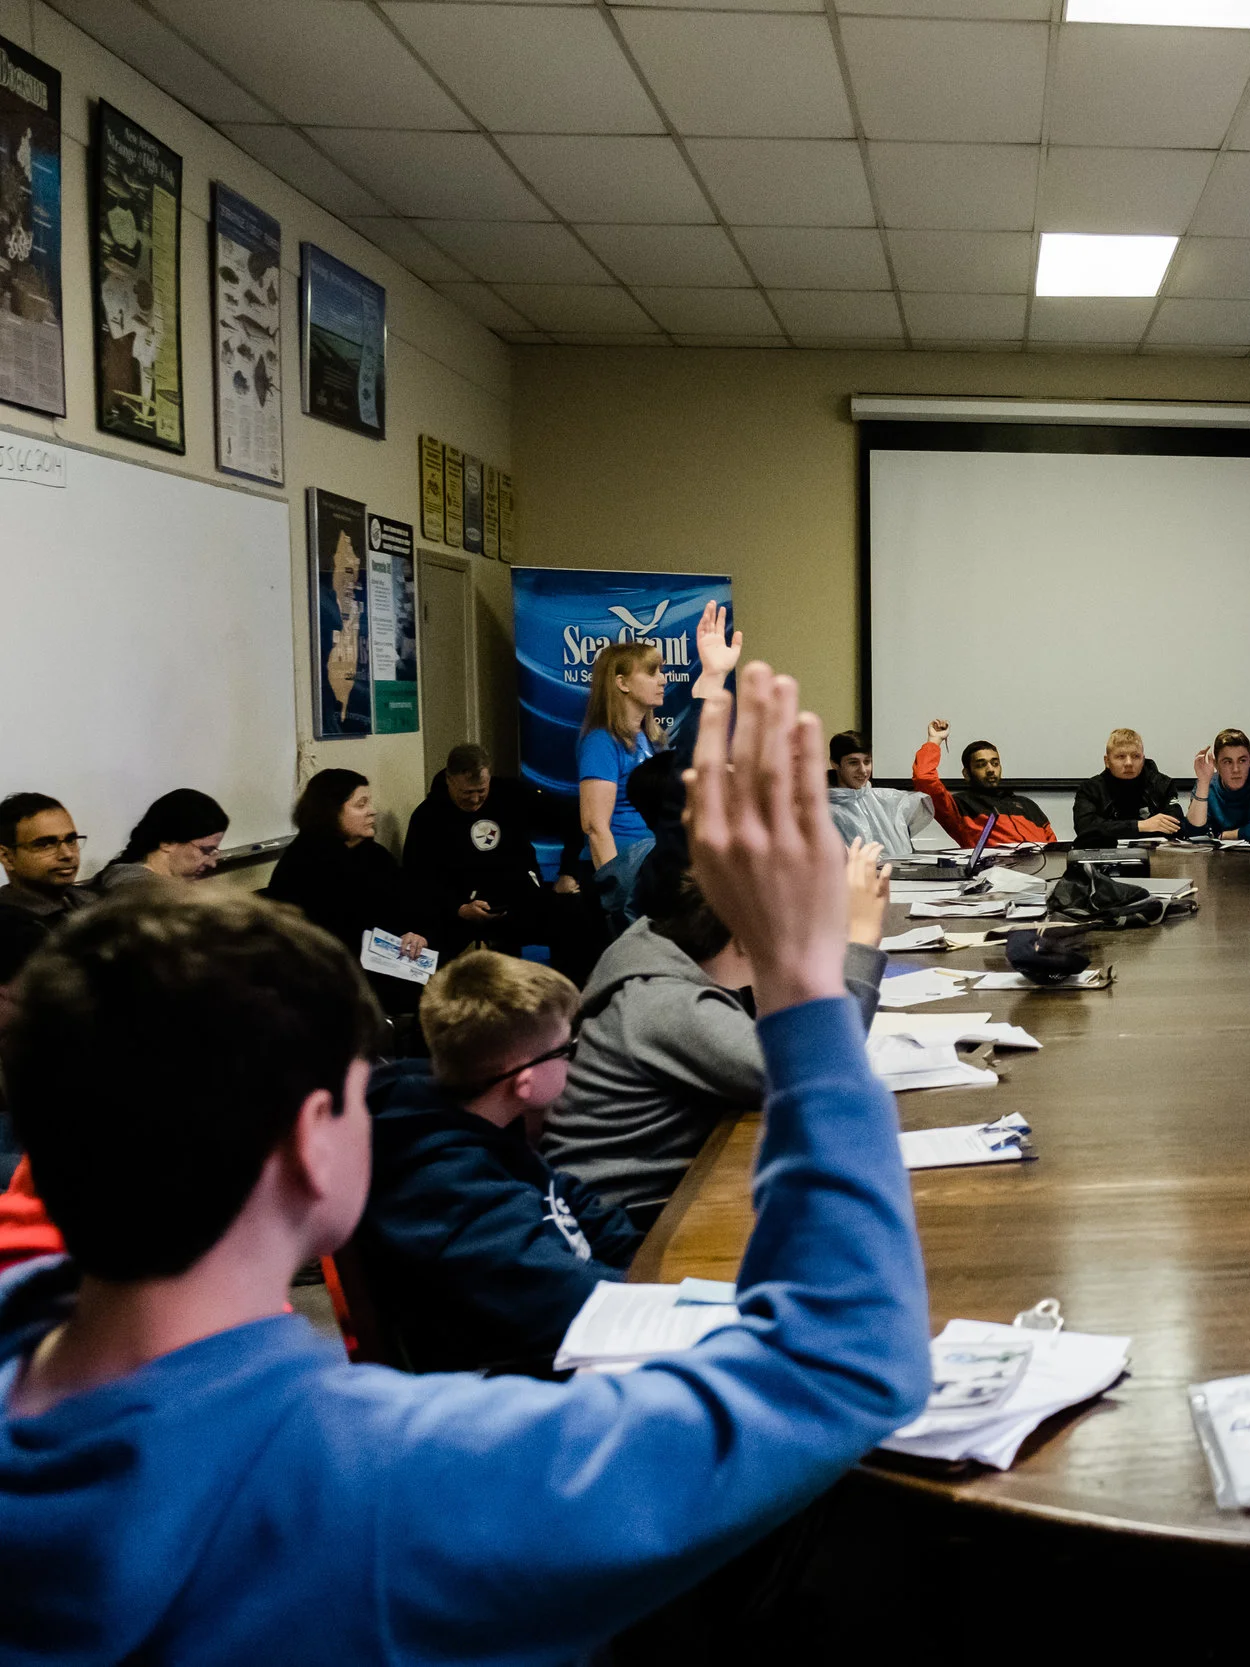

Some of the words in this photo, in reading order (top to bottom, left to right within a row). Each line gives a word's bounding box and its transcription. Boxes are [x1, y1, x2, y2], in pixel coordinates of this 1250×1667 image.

[564, 625, 612, 666] Sea
[564, 670, 578, 682] NJ
[580, 670, 593, 683] Se
